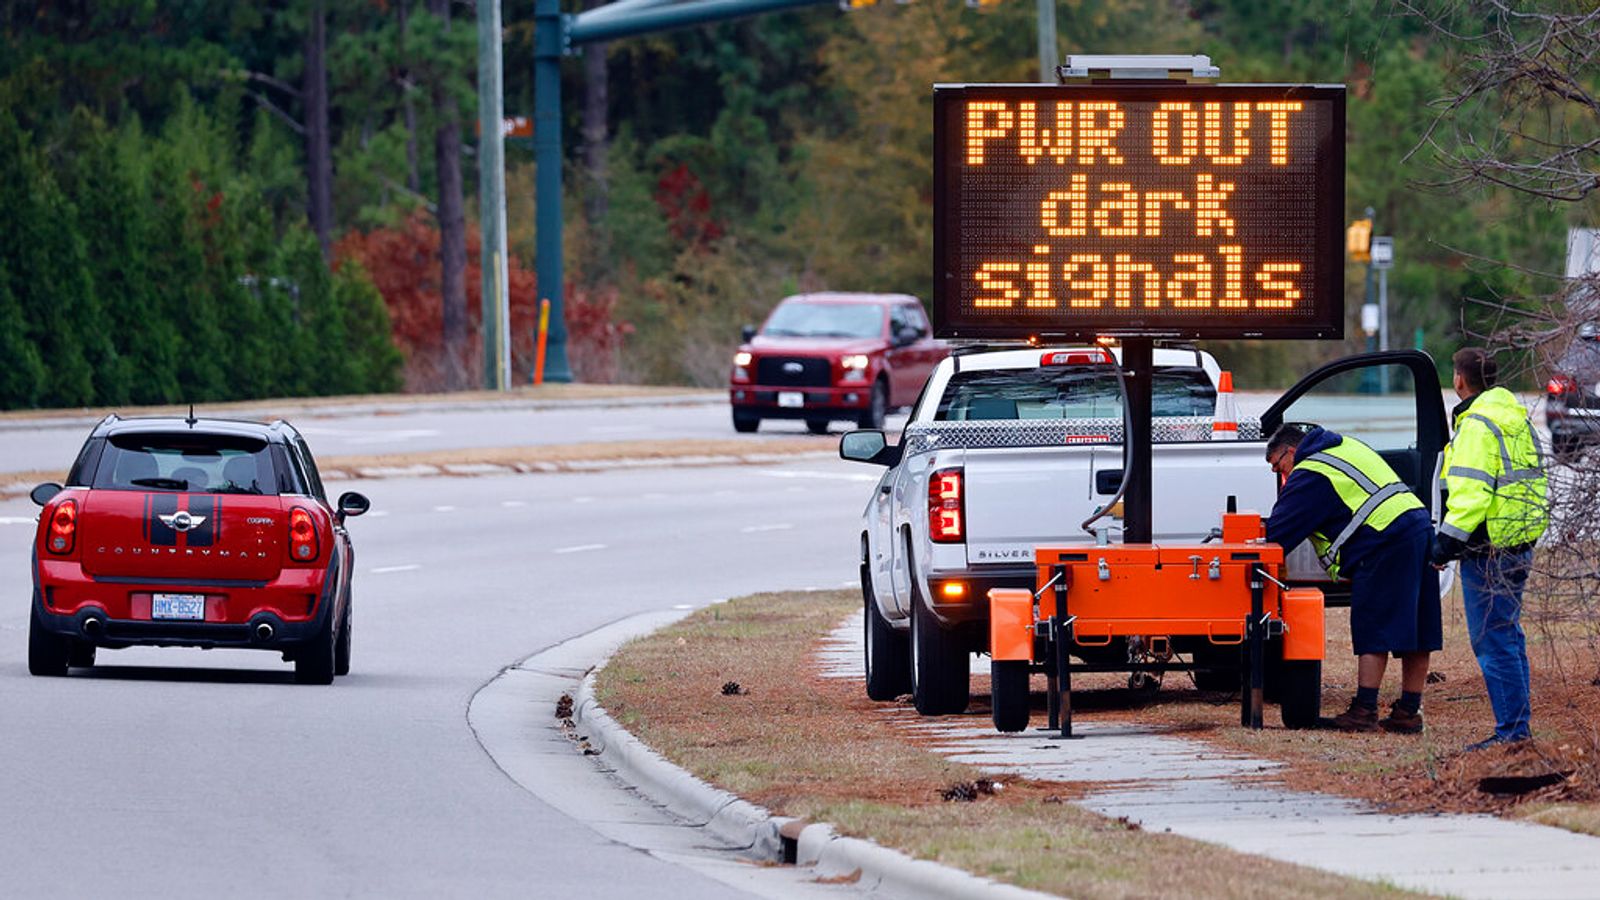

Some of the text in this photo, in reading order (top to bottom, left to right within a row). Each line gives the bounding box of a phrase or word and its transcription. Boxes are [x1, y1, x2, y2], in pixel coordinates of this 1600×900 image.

[966, 102, 1303, 165] PWR OUT
[1041, 174, 1236, 237] dark
[974, 245, 1302, 309] signals
[97, 547, 266, 557] COUNTRYMAN
[979, 550, 1030, 559] SILVER
